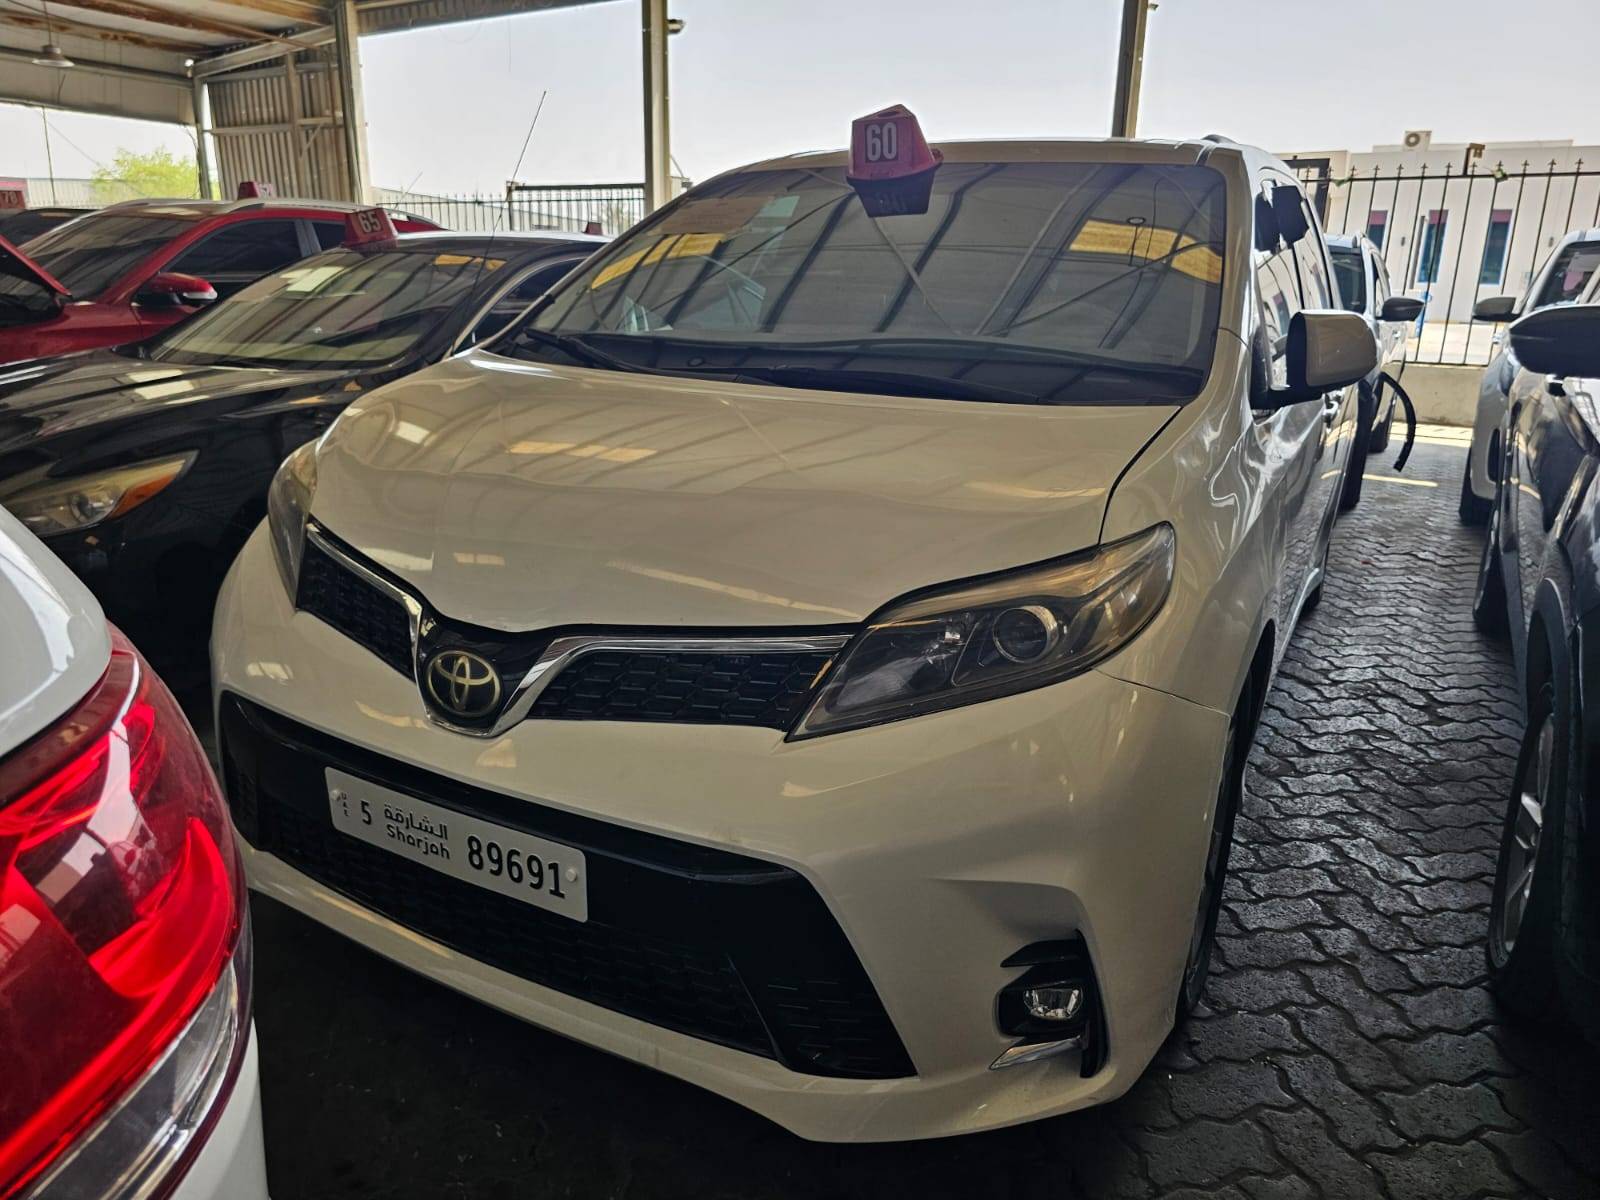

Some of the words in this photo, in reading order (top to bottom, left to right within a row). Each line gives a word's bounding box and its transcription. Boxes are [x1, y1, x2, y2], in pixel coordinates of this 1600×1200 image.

[866, 122, 897, 161] 60
[358, 211, 381, 233] 65
[360, 800, 372, 825] 5
[384, 803, 448, 840] الشارقة
[386, 823, 450, 859] Sharjah
[467, 835, 565, 899] 89691
